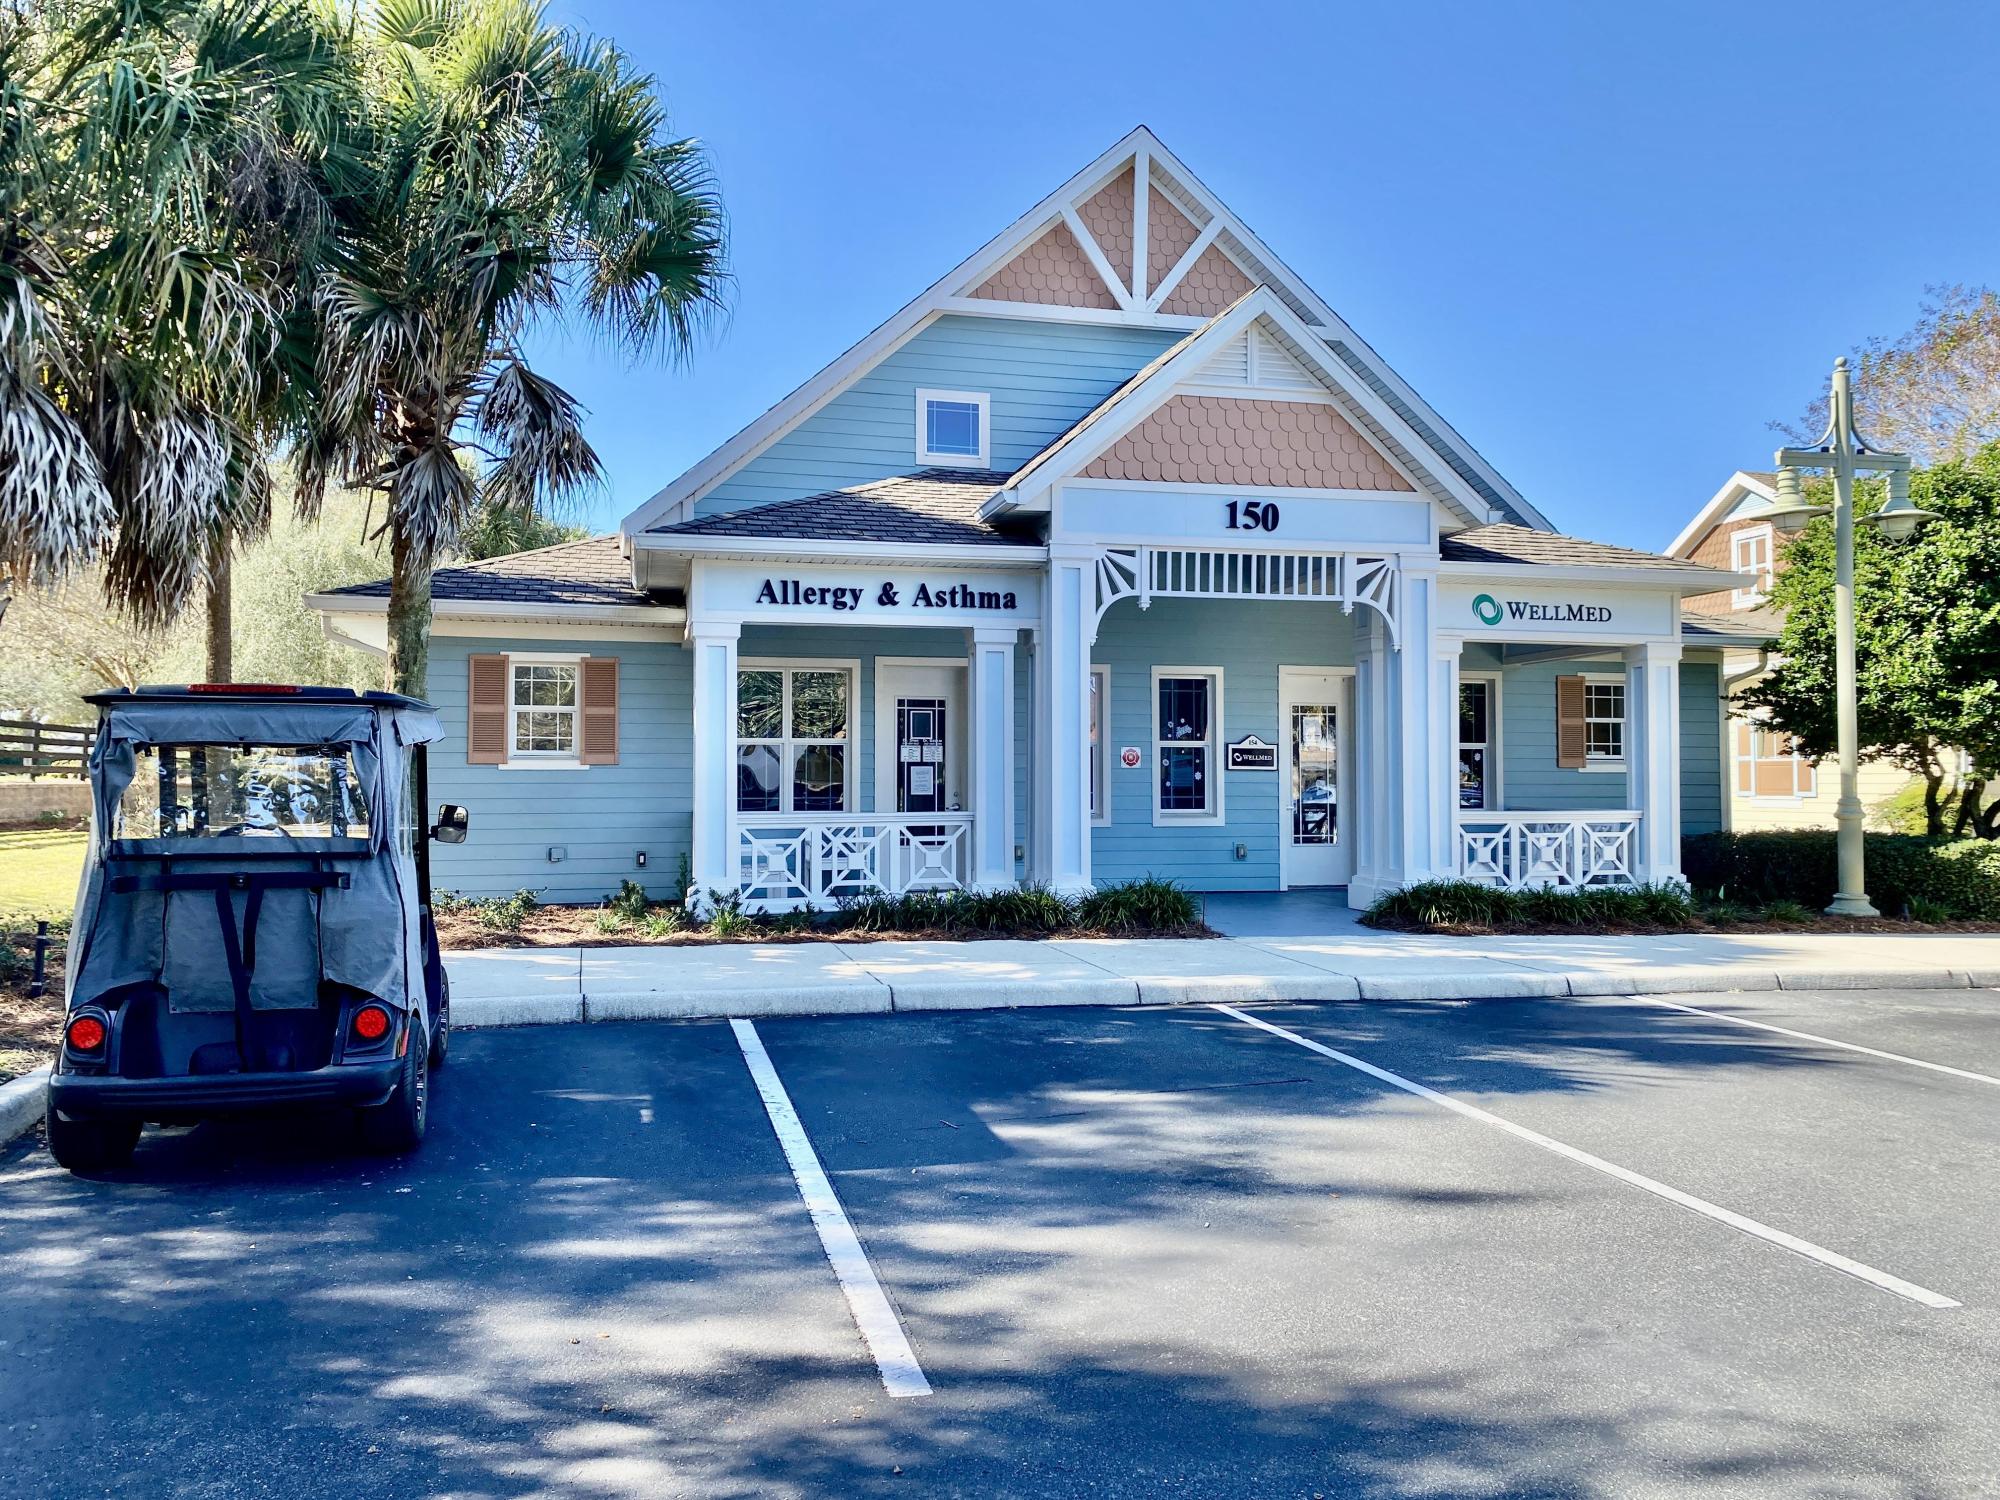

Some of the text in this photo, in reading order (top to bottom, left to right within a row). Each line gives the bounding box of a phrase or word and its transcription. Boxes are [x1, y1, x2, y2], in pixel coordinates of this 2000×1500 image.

[1225, 500, 1280, 532] 150
[756, 579, 1018, 611] Allergy & Asthma
